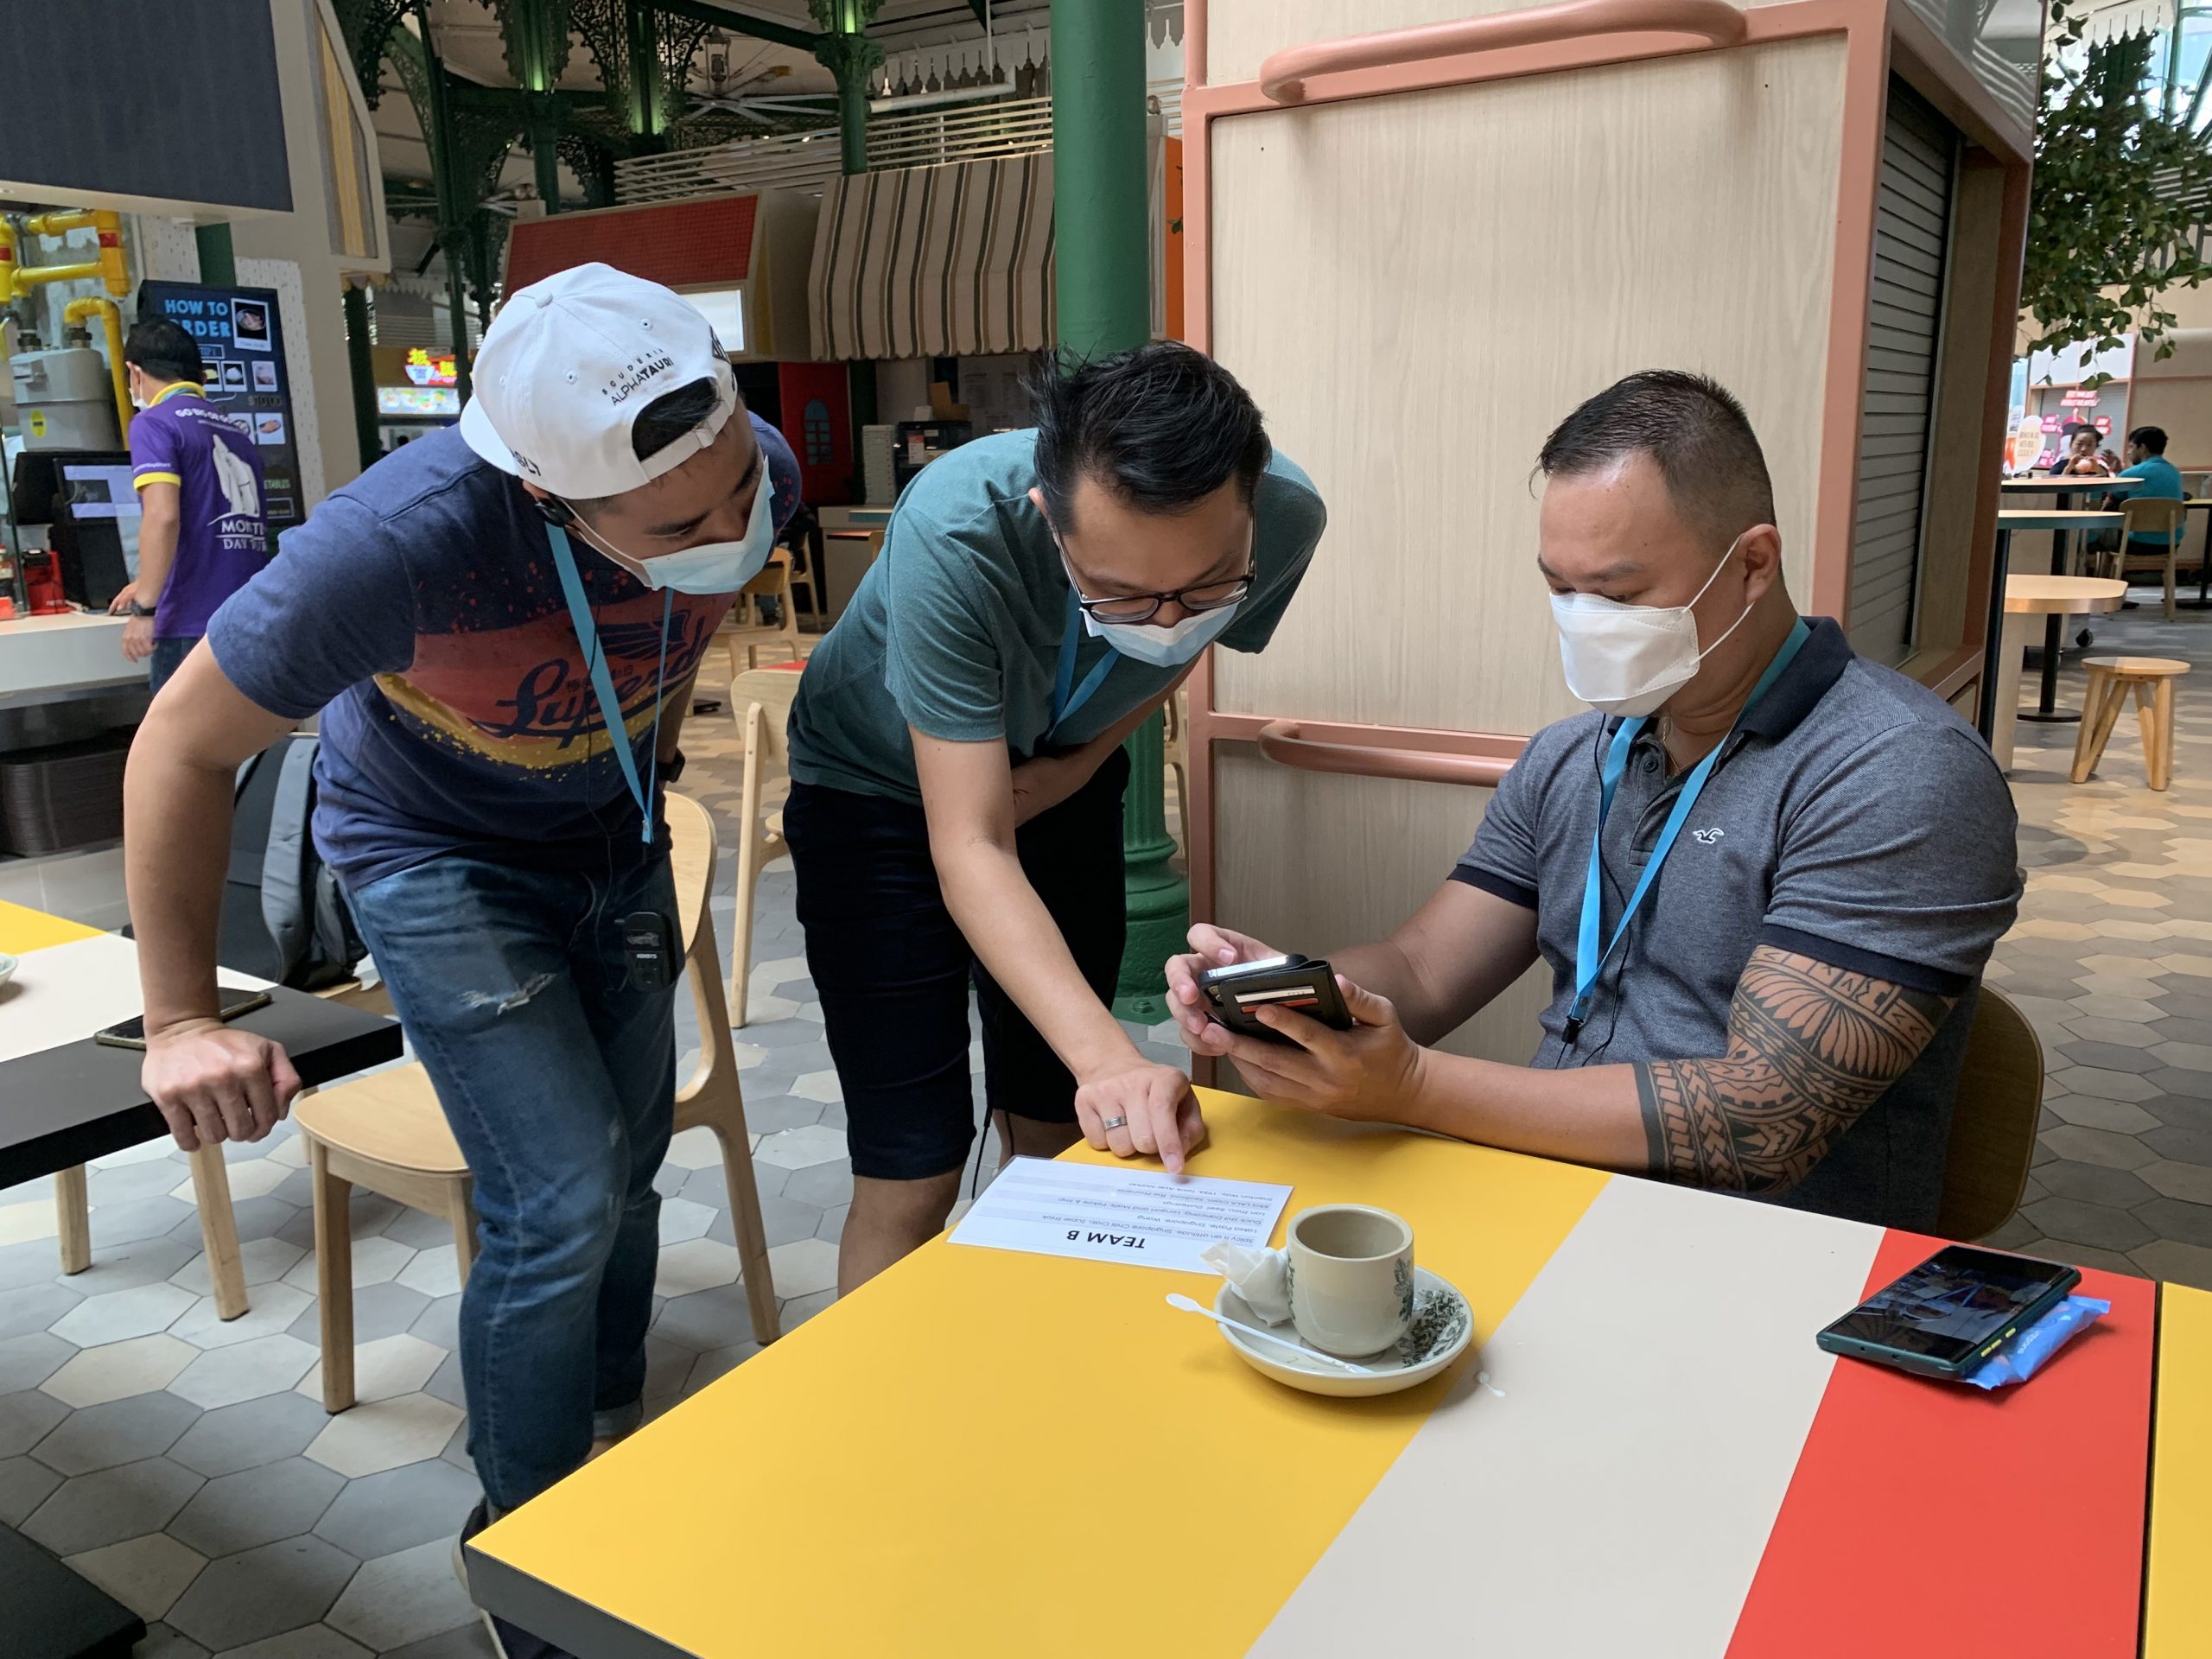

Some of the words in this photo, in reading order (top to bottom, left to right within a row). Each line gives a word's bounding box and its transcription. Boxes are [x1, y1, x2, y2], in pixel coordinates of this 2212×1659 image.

[164, 299, 203, 315] HOW
[207, 302, 228, 315] TO
[170, 319, 232, 337] RDER
[601, 348, 664, 395] SCUDERIA
[611, 357, 674, 406] ALPHATAURI
[223, 538, 247, 550] DAY
[1067, 1230, 1080, 1240] B
[1132, 1224, 1173, 1233] Singapore
[1087, 1232, 1145, 1249] TEAM
